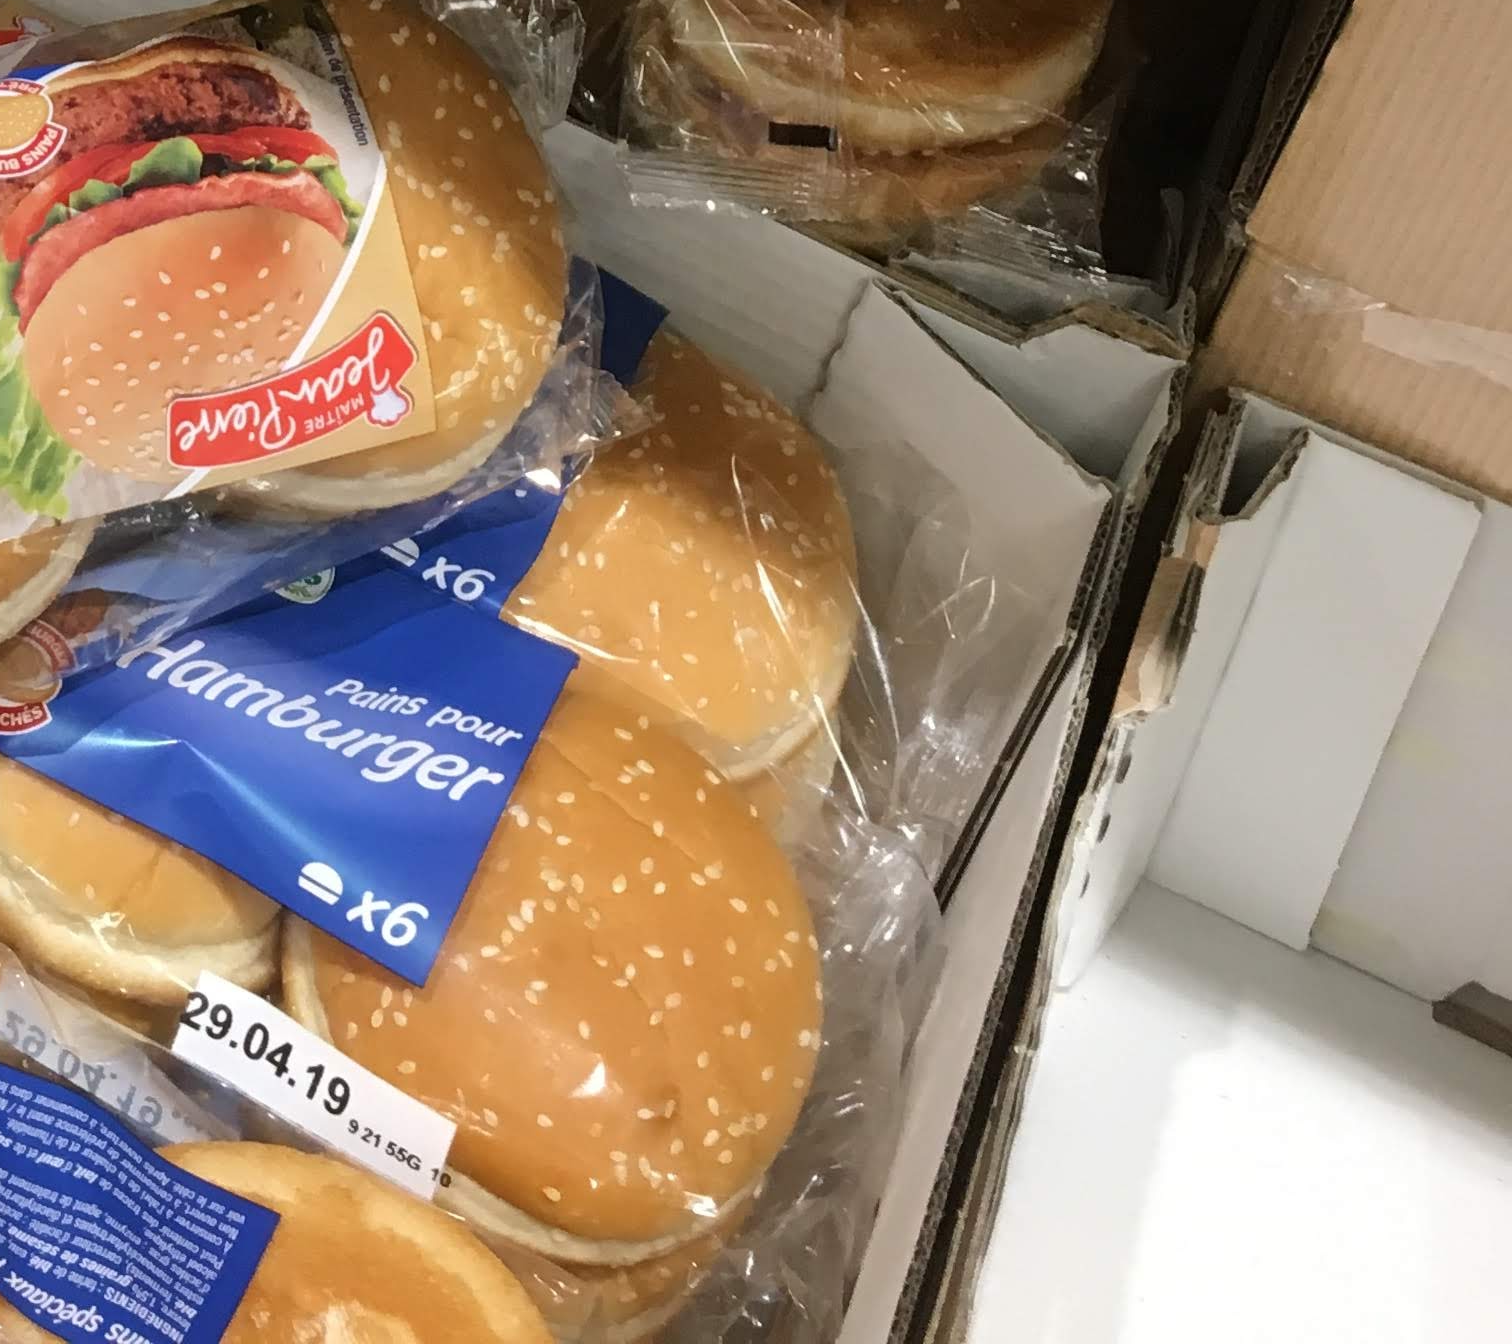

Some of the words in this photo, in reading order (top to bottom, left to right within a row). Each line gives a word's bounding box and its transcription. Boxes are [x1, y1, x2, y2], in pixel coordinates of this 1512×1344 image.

[20, 125, 58, 169] PAINS
[331, 85, 369, 149] présentation
[268, 326, 390, 404] Jean
[174, 387, 296, 451] Pierre
[303, 393, 368, 434] MAÎTRE
[420, 554, 497, 603] x6
[114, 638, 506, 804] Hamburger
[324, 678, 428, 718] Pains
[434, 703, 524, 750] pour
[346, 892, 429, 950] x6
[176, 991, 350, 1116] 29.04.19
[359, 1126, 384, 1149] 21
[2, 1270, 104, 1332] spéciaux
